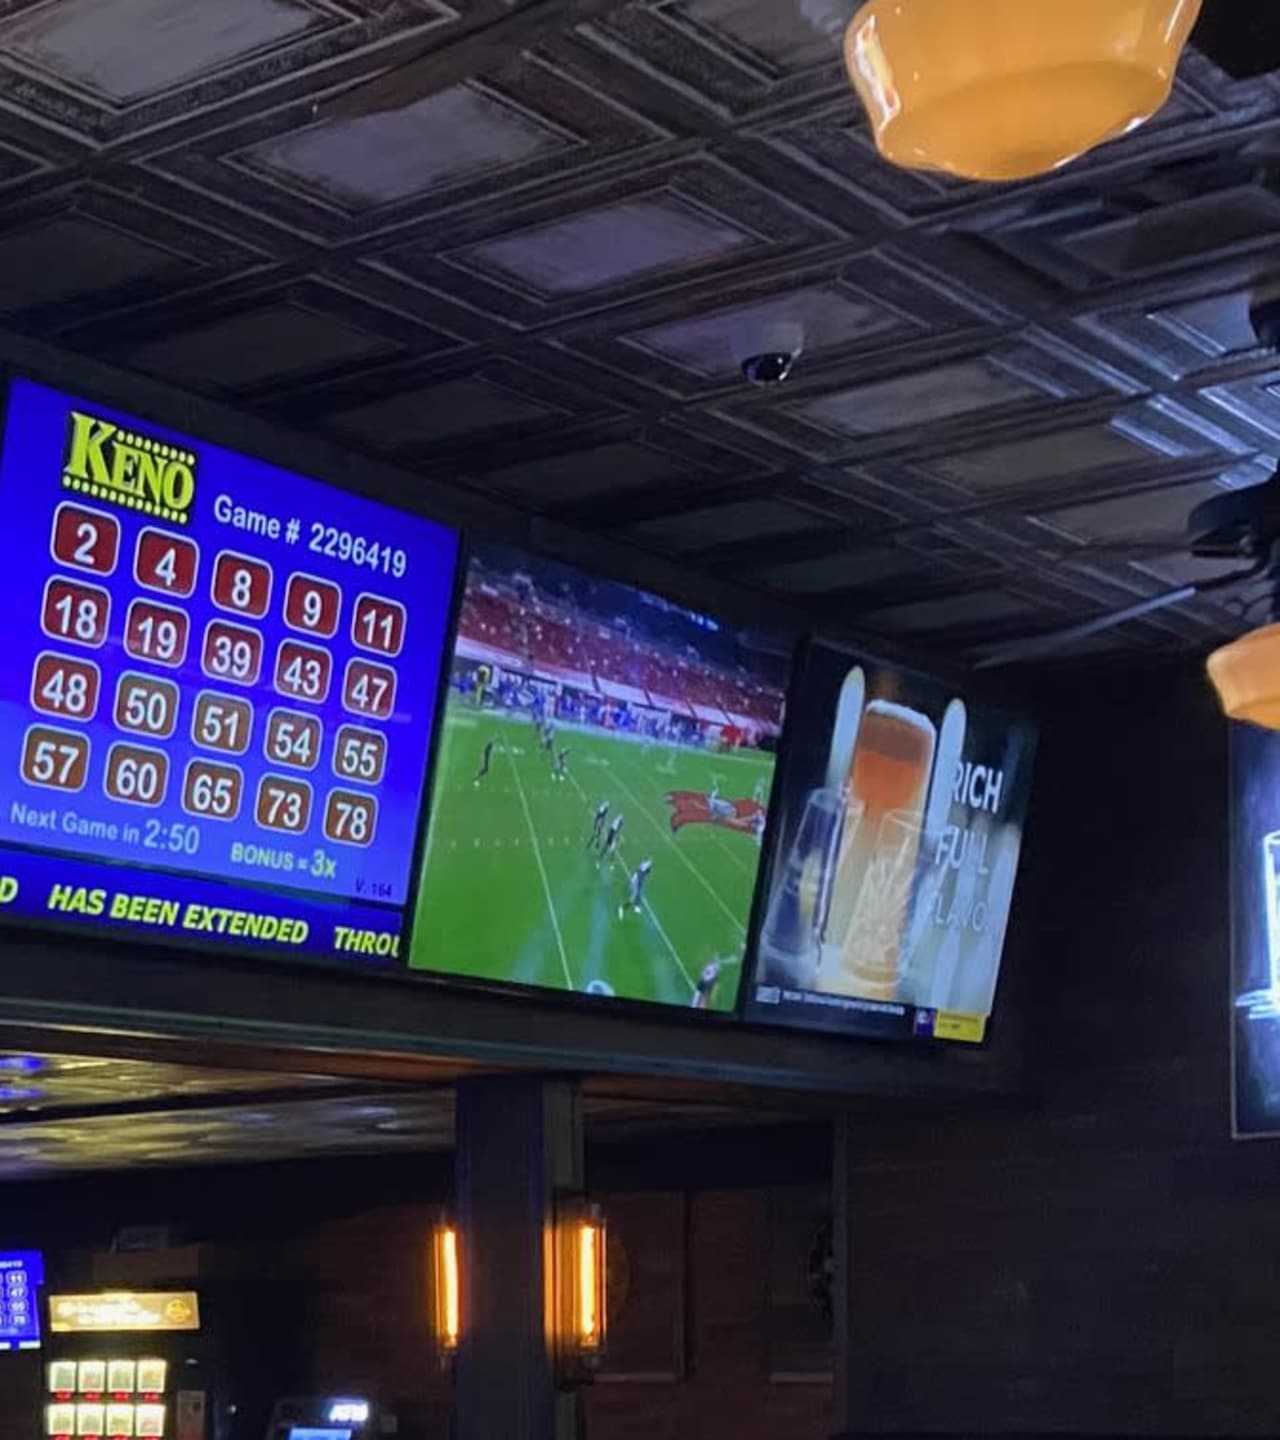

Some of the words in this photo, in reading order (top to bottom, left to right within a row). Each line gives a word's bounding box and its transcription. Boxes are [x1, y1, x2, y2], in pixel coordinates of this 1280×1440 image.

[63, 411, 195, 510] KENO
[214, 494, 281, 539] Game
[285, 517, 300, 545] #
[308, 522, 407, 578] 2296419
[73, 522, 98, 565] 2
[154, 547, 176, 587] 4
[231, 569, 252, 608] 8
[302, 590, 322, 627] 9
[362, 609, 394, 650] 11
[55, 594, 98, 639] 18
[138, 616, 178, 660] 19
[211, 635, 252, 678] 39
[283, 656, 321, 695] 43
[351, 674, 388, 712] 47
[41, 669, 88, 713] 48
[125, 687, 167, 730] 50
[202, 705, 240, 748] 51
[274, 722, 311, 763] 54
[342, 738, 378, 777] 55
[10, 802, 57, 830] Next
[62, 811, 118, 841] Game
[123, 822, 140, 845] in
[143, 818, 200, 855] 2:50
[32, 741, 80, 785] 57
[115, 758, 158, 800] 60
[193, 774, 233, 814] 65
[268, 788, 302, 828] 73
[335, 802, 368, 840] 78
[951, 761, 1003, 814] RICH
[230, 842, 294, 872] BONUS
[310, 849, 337, 879] 3x
[48, 884, 107, 915] HAS
[110, 893, 180, 927] BEEN
[181, 904, 309, 944] EXTENDED
